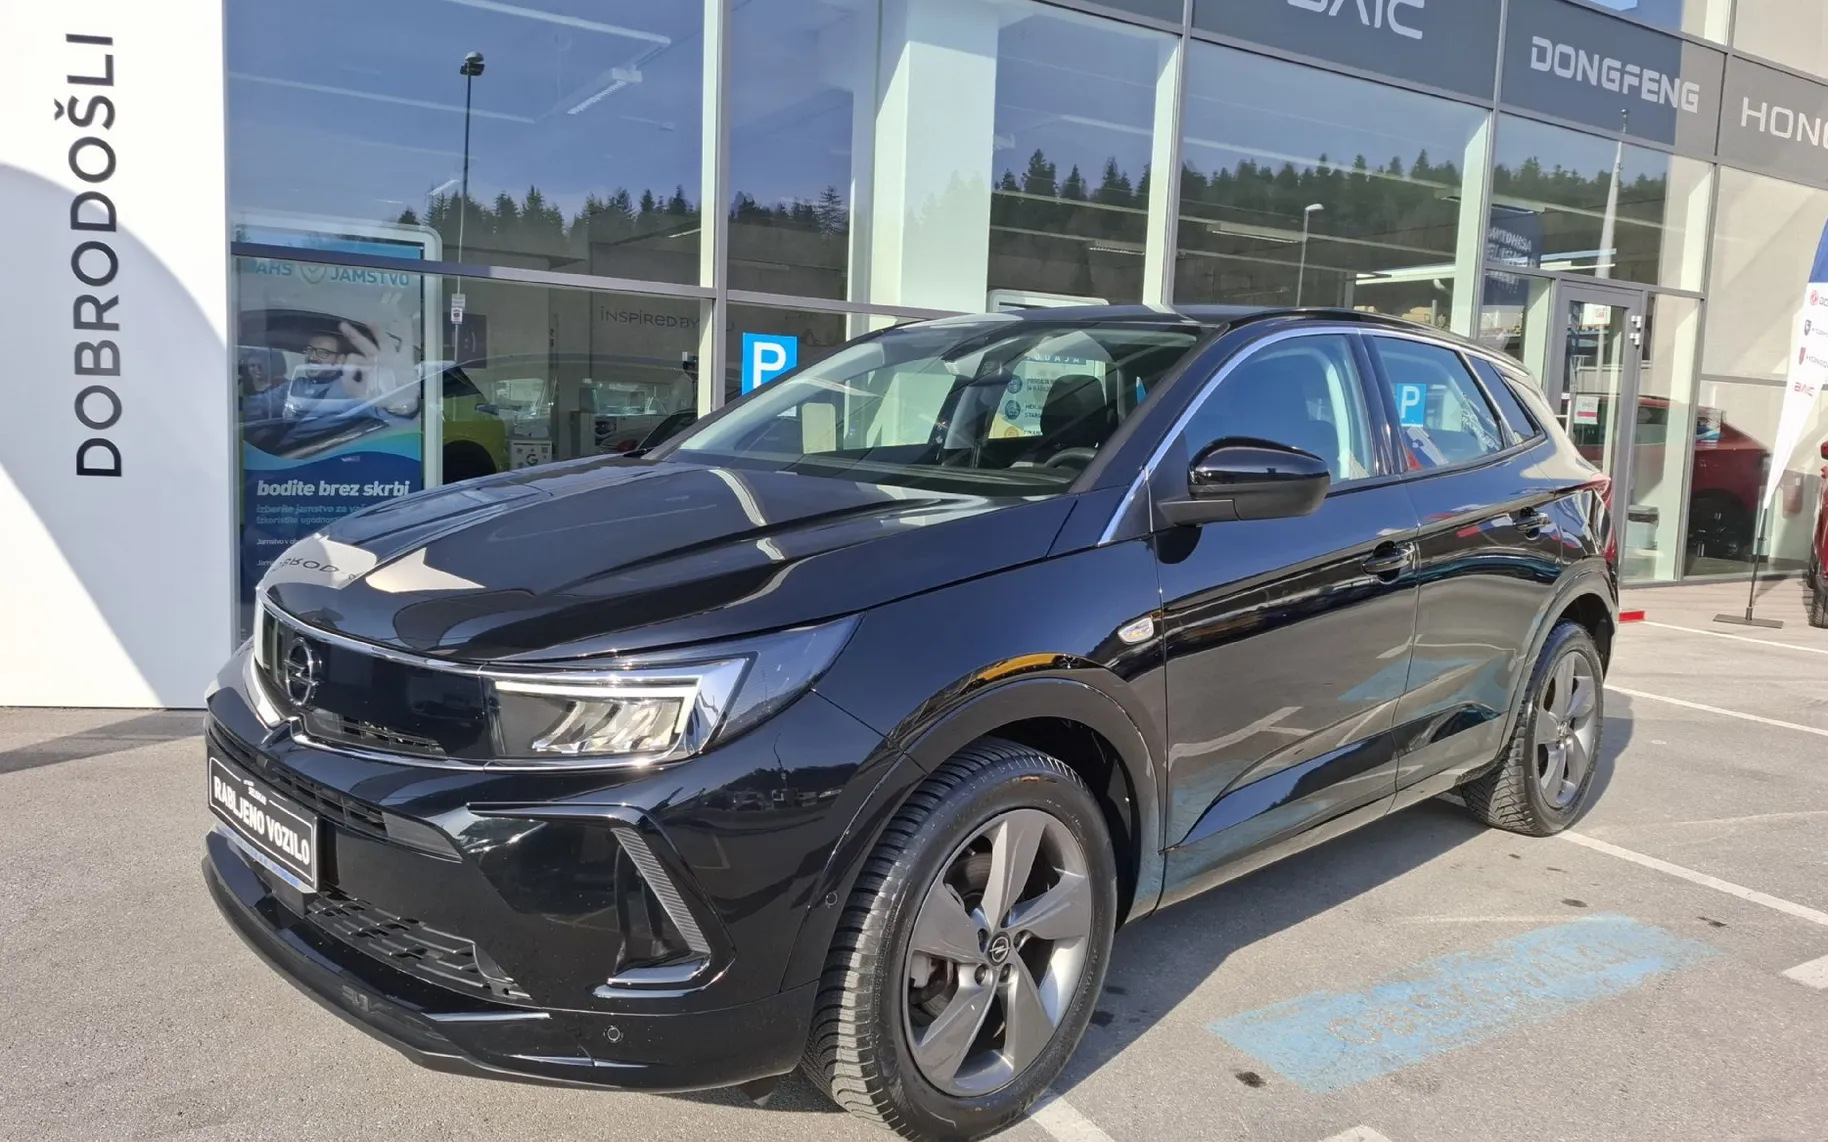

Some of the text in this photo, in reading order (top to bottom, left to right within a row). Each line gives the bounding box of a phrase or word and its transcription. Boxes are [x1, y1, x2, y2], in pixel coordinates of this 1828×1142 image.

[1530, 35, 1700, 114] DONGFENG
[54, 33, 122, 477] DOBRODOŠLI
[330, 268, 410, 286] JAMSTVO
[752, 341, 787, 389] P
[1400, 385, 1420, 419] P
[257, 479, 411, 497] bodite brez skrbi
[213, 775, 266, 835] RABLJENO
[266, 815, 311, 865] VOZILO
